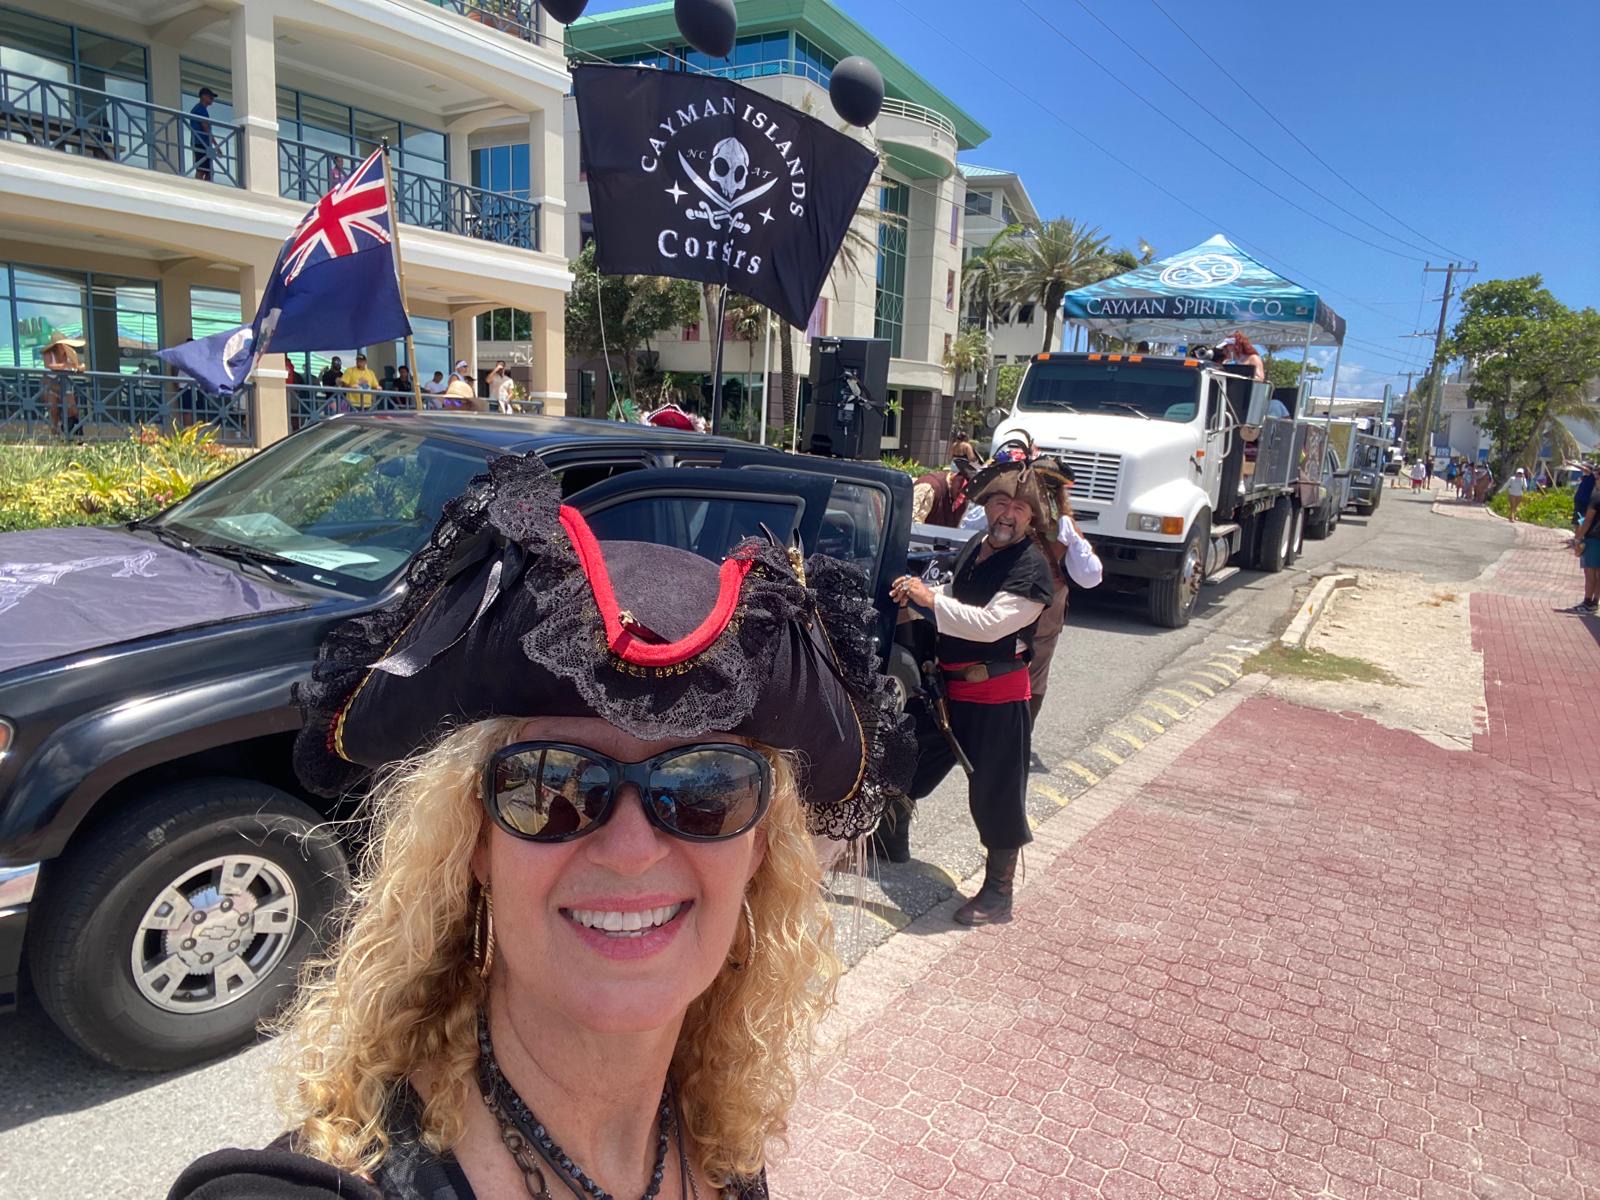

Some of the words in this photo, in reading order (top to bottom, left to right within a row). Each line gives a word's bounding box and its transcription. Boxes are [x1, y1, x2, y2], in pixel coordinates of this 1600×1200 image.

[641, 97, 736, 172] CAYMAN
[741, 104, 806, 218] ISLANDS
[1086, 297, 1166, 316] CAYMAN
[1172, 296, 1240, 316] SPIRITS
[1248, 298, 1285, 317] CO.
